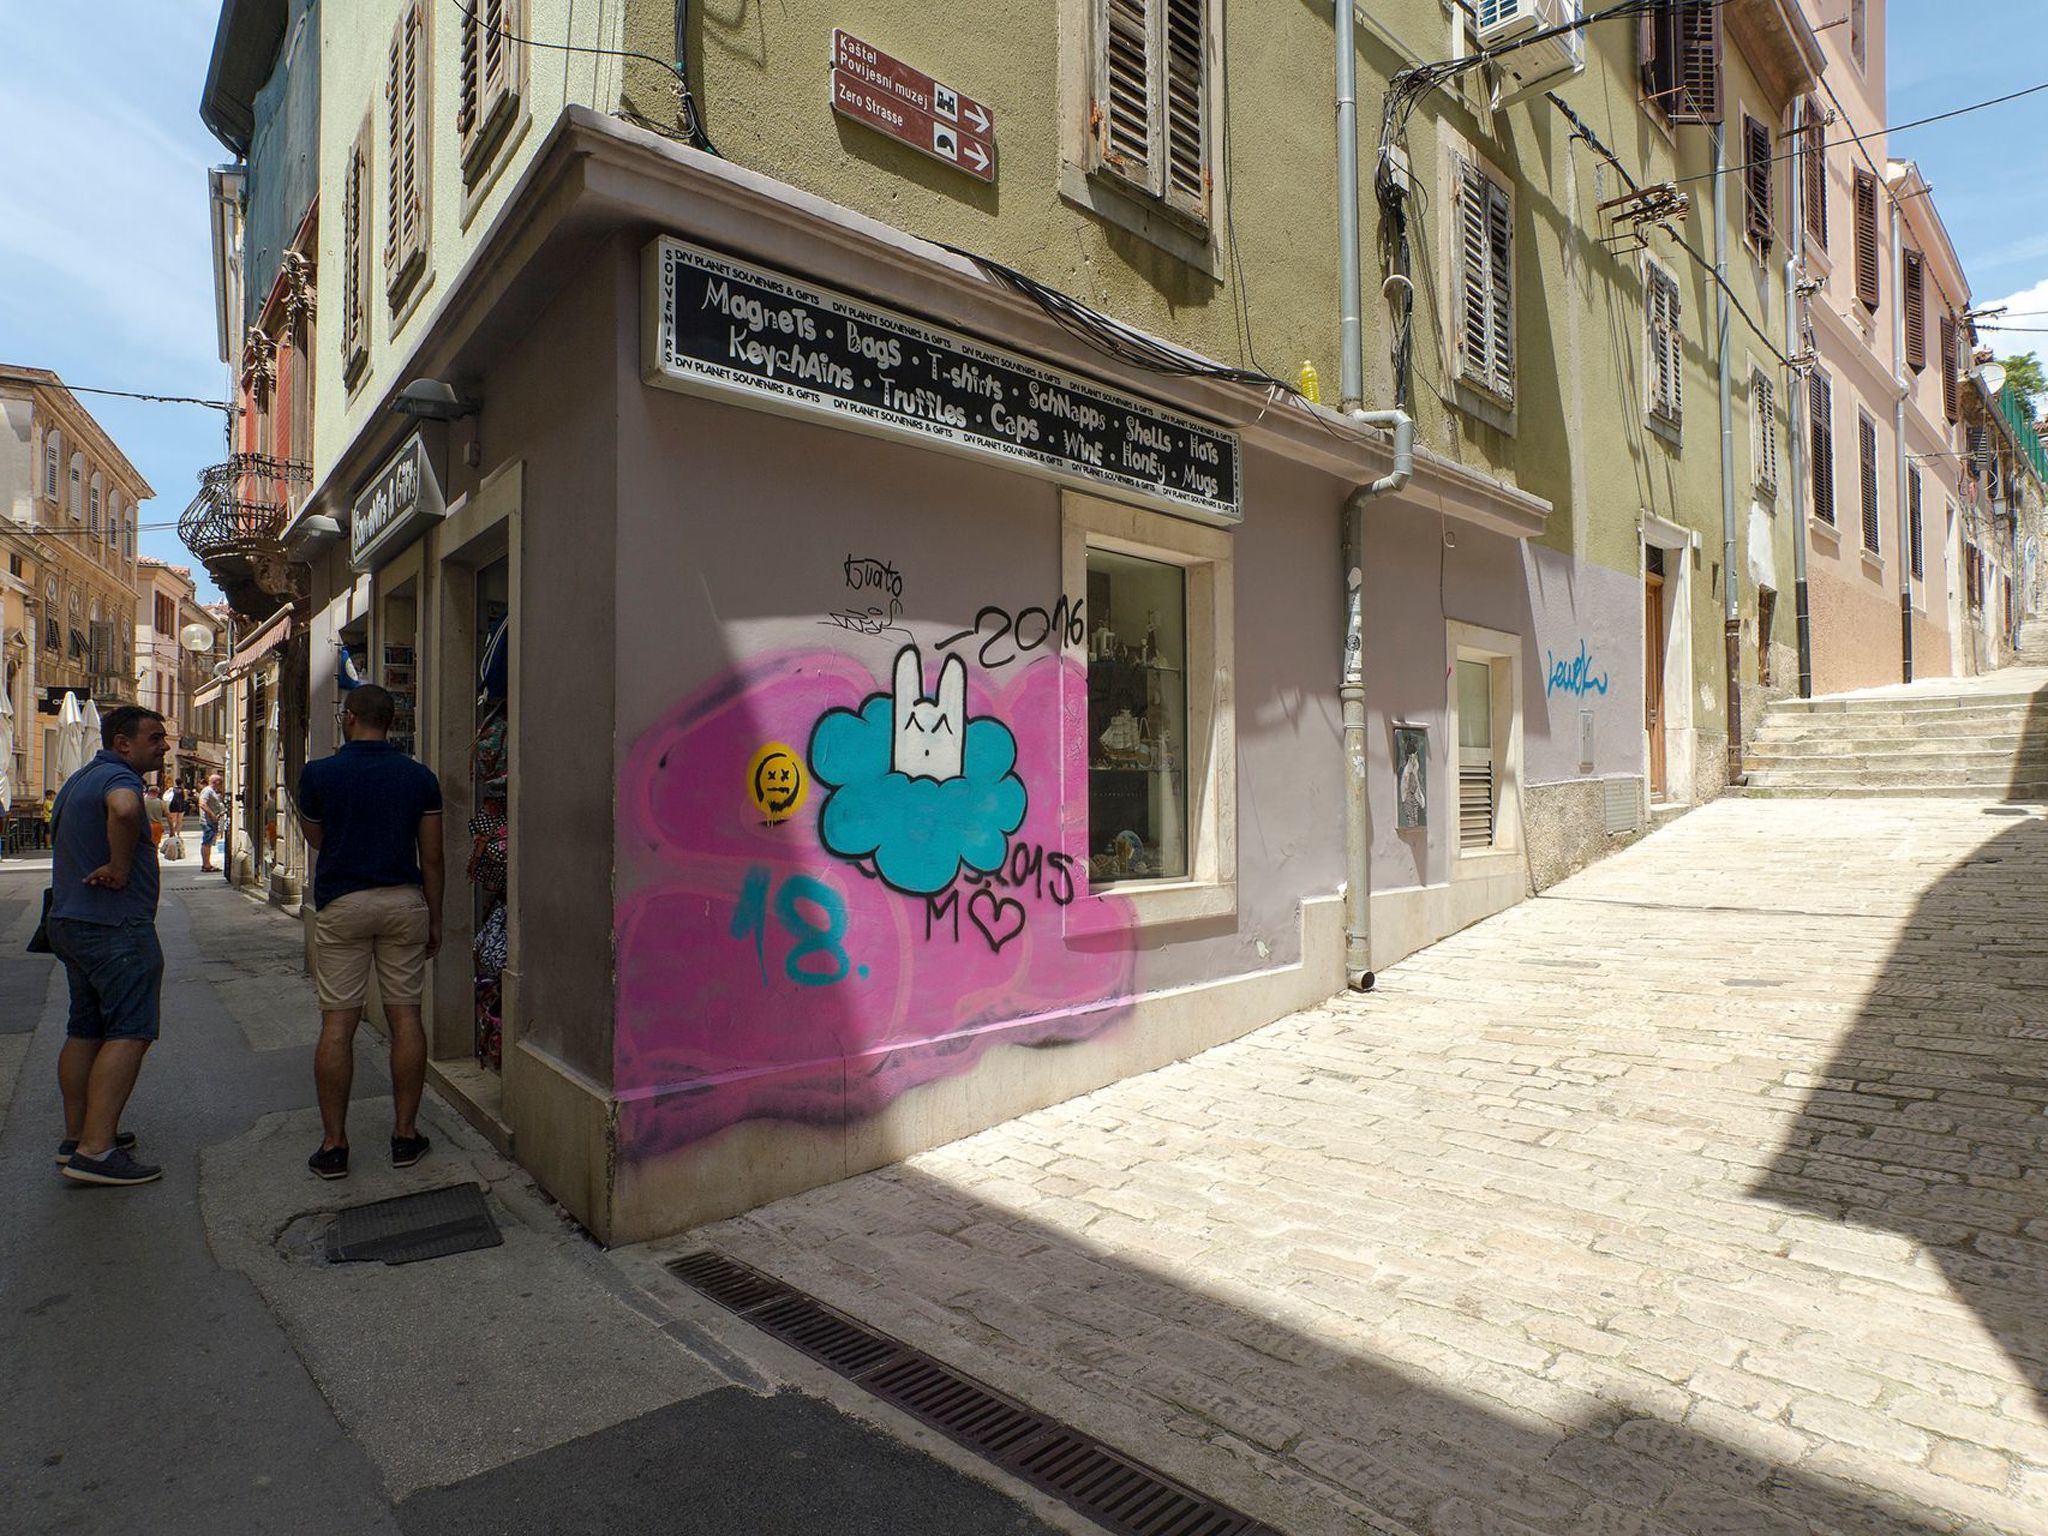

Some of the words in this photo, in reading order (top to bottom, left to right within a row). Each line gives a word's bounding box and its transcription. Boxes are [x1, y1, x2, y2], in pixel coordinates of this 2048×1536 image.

[839, 34, 877, 65] Kaštel
[839, 52, 893, 89] Povijesni
[894, 83, 928, 111] muzej
[839, 83, 863, 107] Zero
[865, 96, 904, 127] Strasse
[695, 257, 731, 276] PLANET
[732, 268, 784, 293] SOUVENIRS
[786, 286, 794, 297] &
[796, 290, 819, 305] GIFTS
[665, 249, 674, 363] SOUVENIRS
[849, 307, 878, 324] PLANET
[879, 318, 922, 339] SOUVENIRS
[923, 332, 930, 341] &
[931, 335, 952, 348] GIFTS
[695, 360, 731, 379] PLANET
[732, 370, 785, 395] SOUVENIRS
[787, 386, 795, 396] &
[797, 388, 820, 403] GIFTS
[926, 348, 1003, 400] T-shirts
[975, 350, 1000, 365] PLANET
[1001, 358, 1037, 377] SOUVENIRS
[1038, 371, 1043, 379] &
[1044, 373, 1061, 385] GIFTS
[850, 402, 879, 418] PLANET
[880, 411, 923, 430] SOUVENIRS
[925, 423, 931, 432] &
[932, 425, 953, 438] GIFTS
[977, 437, 1001, 450] PLANET
[1002, 444, 1038, 460] SOUVENIRS
[1040, 454, 1045, 462] &
[1046, 456, 1063, 467] GIFTS
[990, 402, 1040, 443] Caps
[1182, 464, 1218, 498] Mugs
